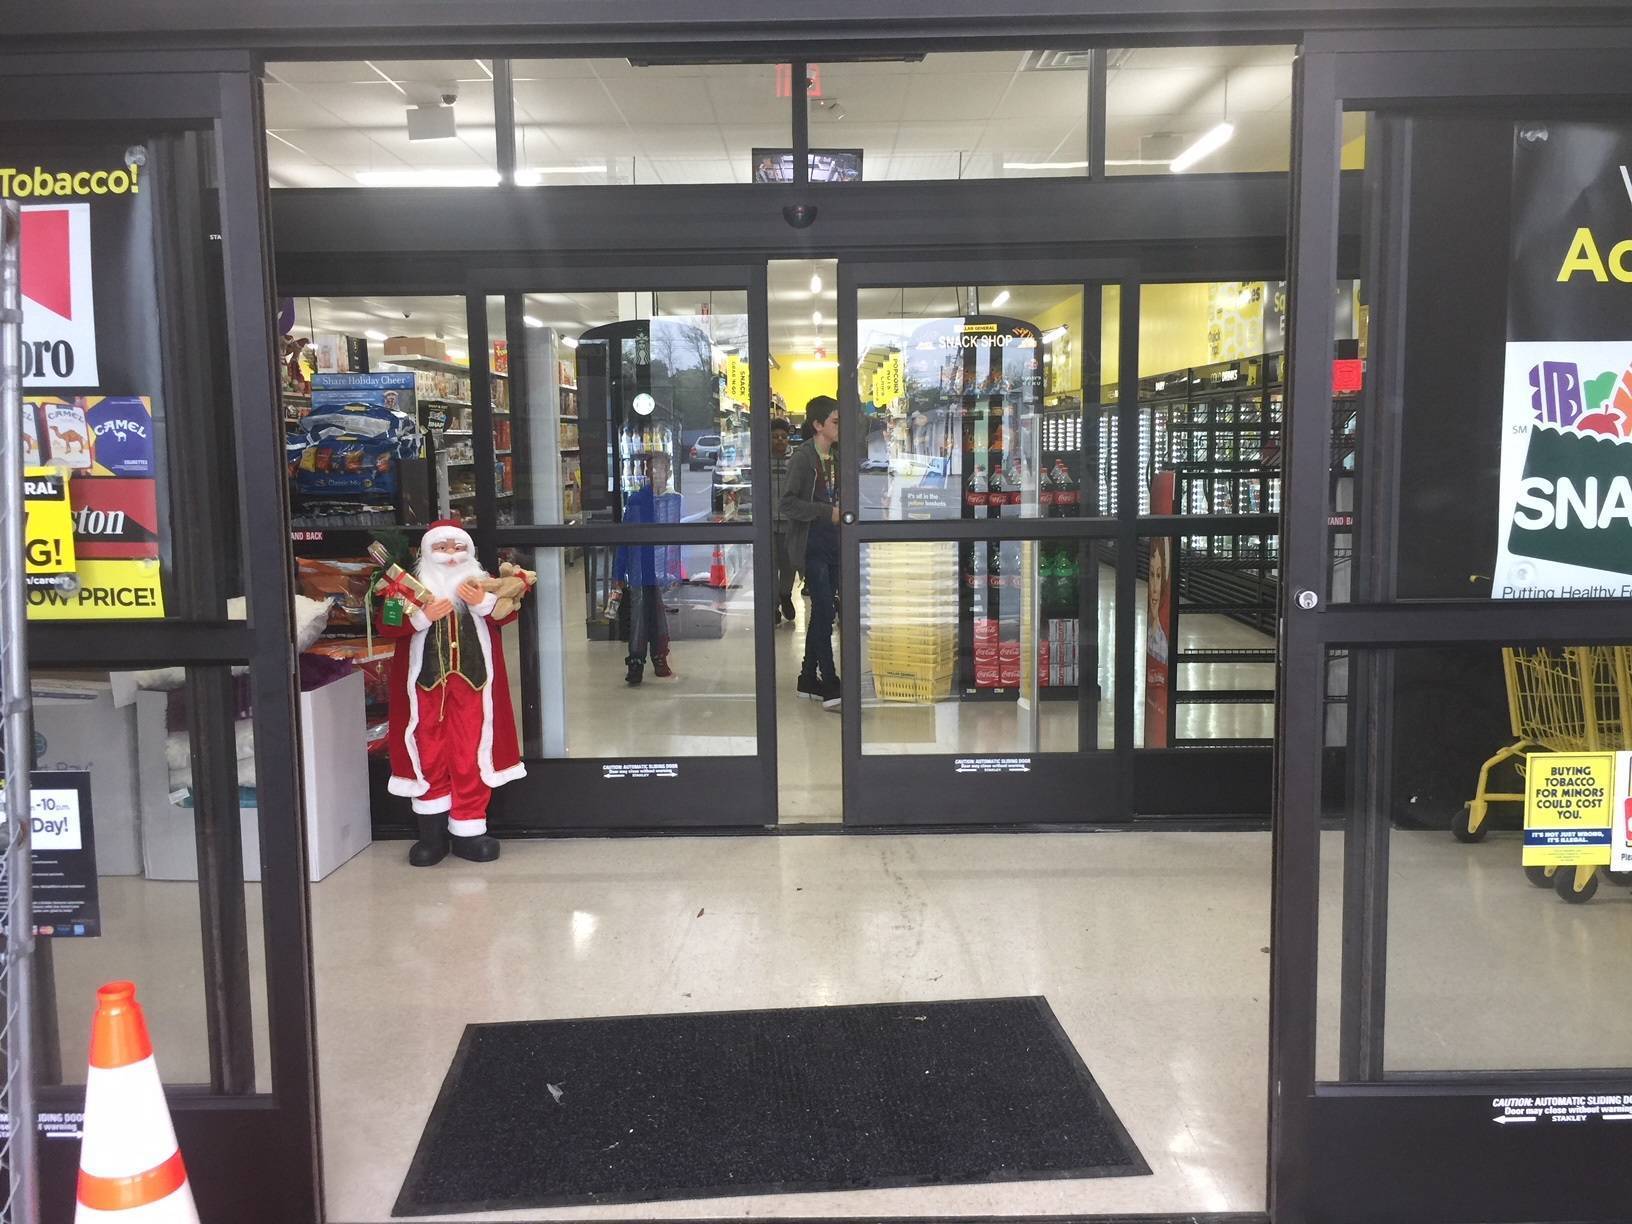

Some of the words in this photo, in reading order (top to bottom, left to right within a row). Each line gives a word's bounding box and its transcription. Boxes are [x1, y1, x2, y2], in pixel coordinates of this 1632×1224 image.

[0, 164, 139, 197] Tobacco!
[940, 334, 978, 349] SNACK
[981, 334, 1013, 347] SHOP
[322, 376, 346, 385] Share
[348, 375, 379, 386] Holiday
[380, 375, 405, 384] Cheer
[94, 419, 147, 438] CAMEL
[305, 532, 323, 540] BACK
[79, 588, 157, 606] PRICE!
[1502, 586, 1555, 599] Putting
[1560, 585, 1616, 598] Healthy
[1551, 767, 1591, 776] BUYING
[1545, 777, 1595, 787] TOBACCO
[1536, 789, 1557, 798] FOR
[1561, 788, 1604, 798] MINORS
[1537, 800, 1572, 809] COULD
[1576, 799, 1603, 808] COST
[1557, 810, 1582, 819] YOU.
[31, 816, 69, 836] Day!
[1492, 1098, 1533, 1107] CAUTION:
[1534, 1096, 1586, 1106] AUTOMATIC
[1587, 1096, 1622, 1105] SLIDING
[1505, 1107, 1524, 1115] Door
[1526, 1108, 1543, 1116] may
[1544, 1106, 1567, 1114] close
[1568, 1105, 1600, 1114] without
[43, 1124, 77, 1132] warning
